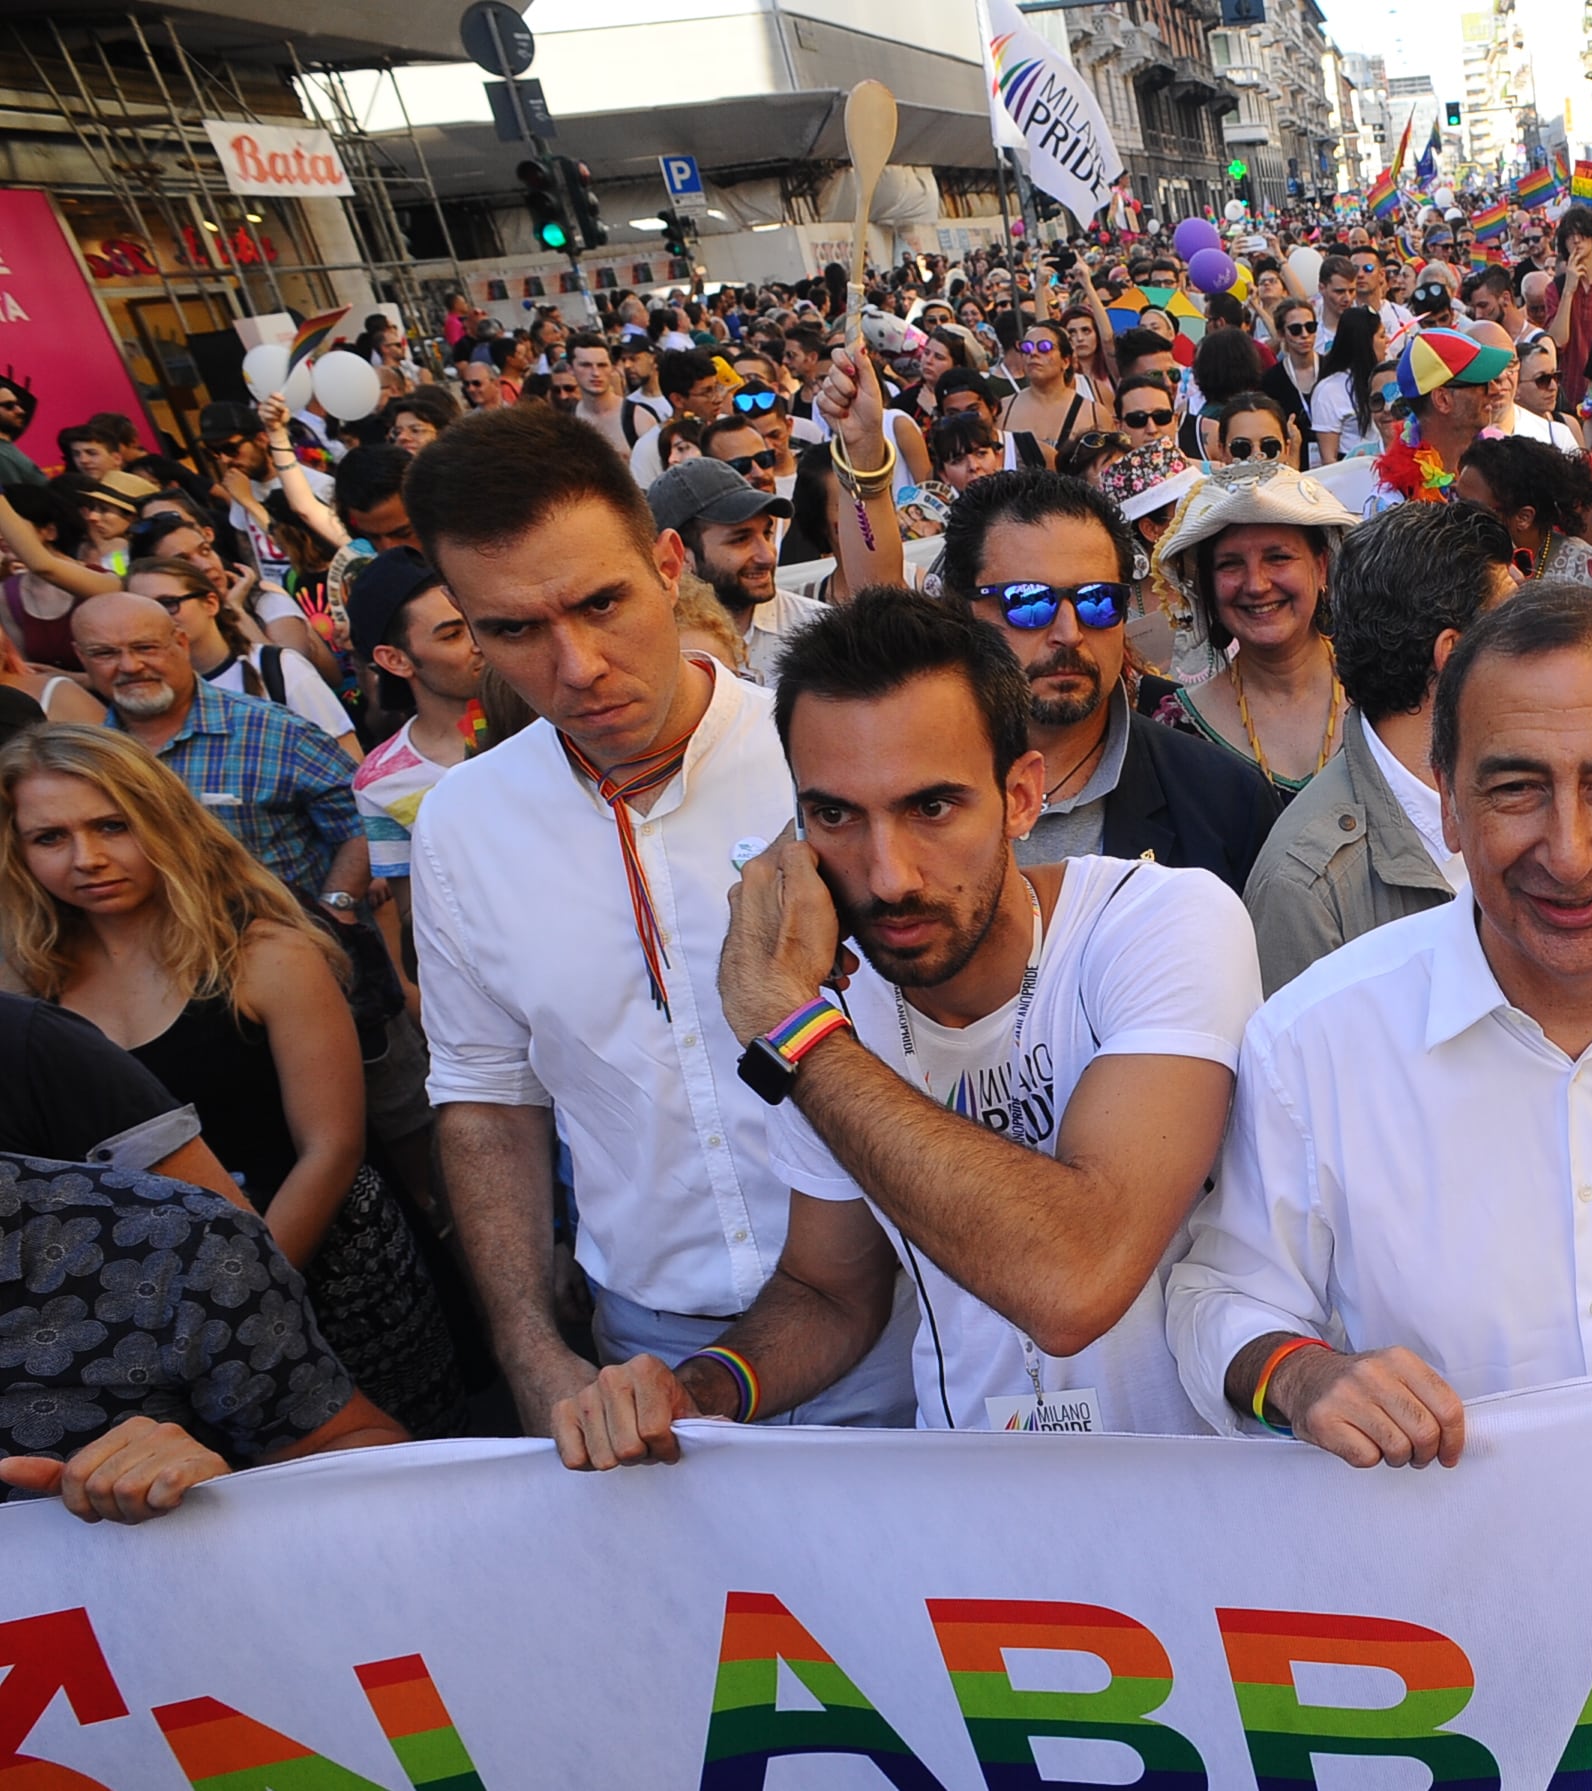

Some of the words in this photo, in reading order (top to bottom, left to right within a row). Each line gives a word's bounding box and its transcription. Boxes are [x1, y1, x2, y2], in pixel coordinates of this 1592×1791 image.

[230, 133, 345, 185] Bata
[1023, 99, 1105, 202] PRIDE
[669, 160, 692, 190] P
[1036, 1401, 1091, 1424] MILANO
